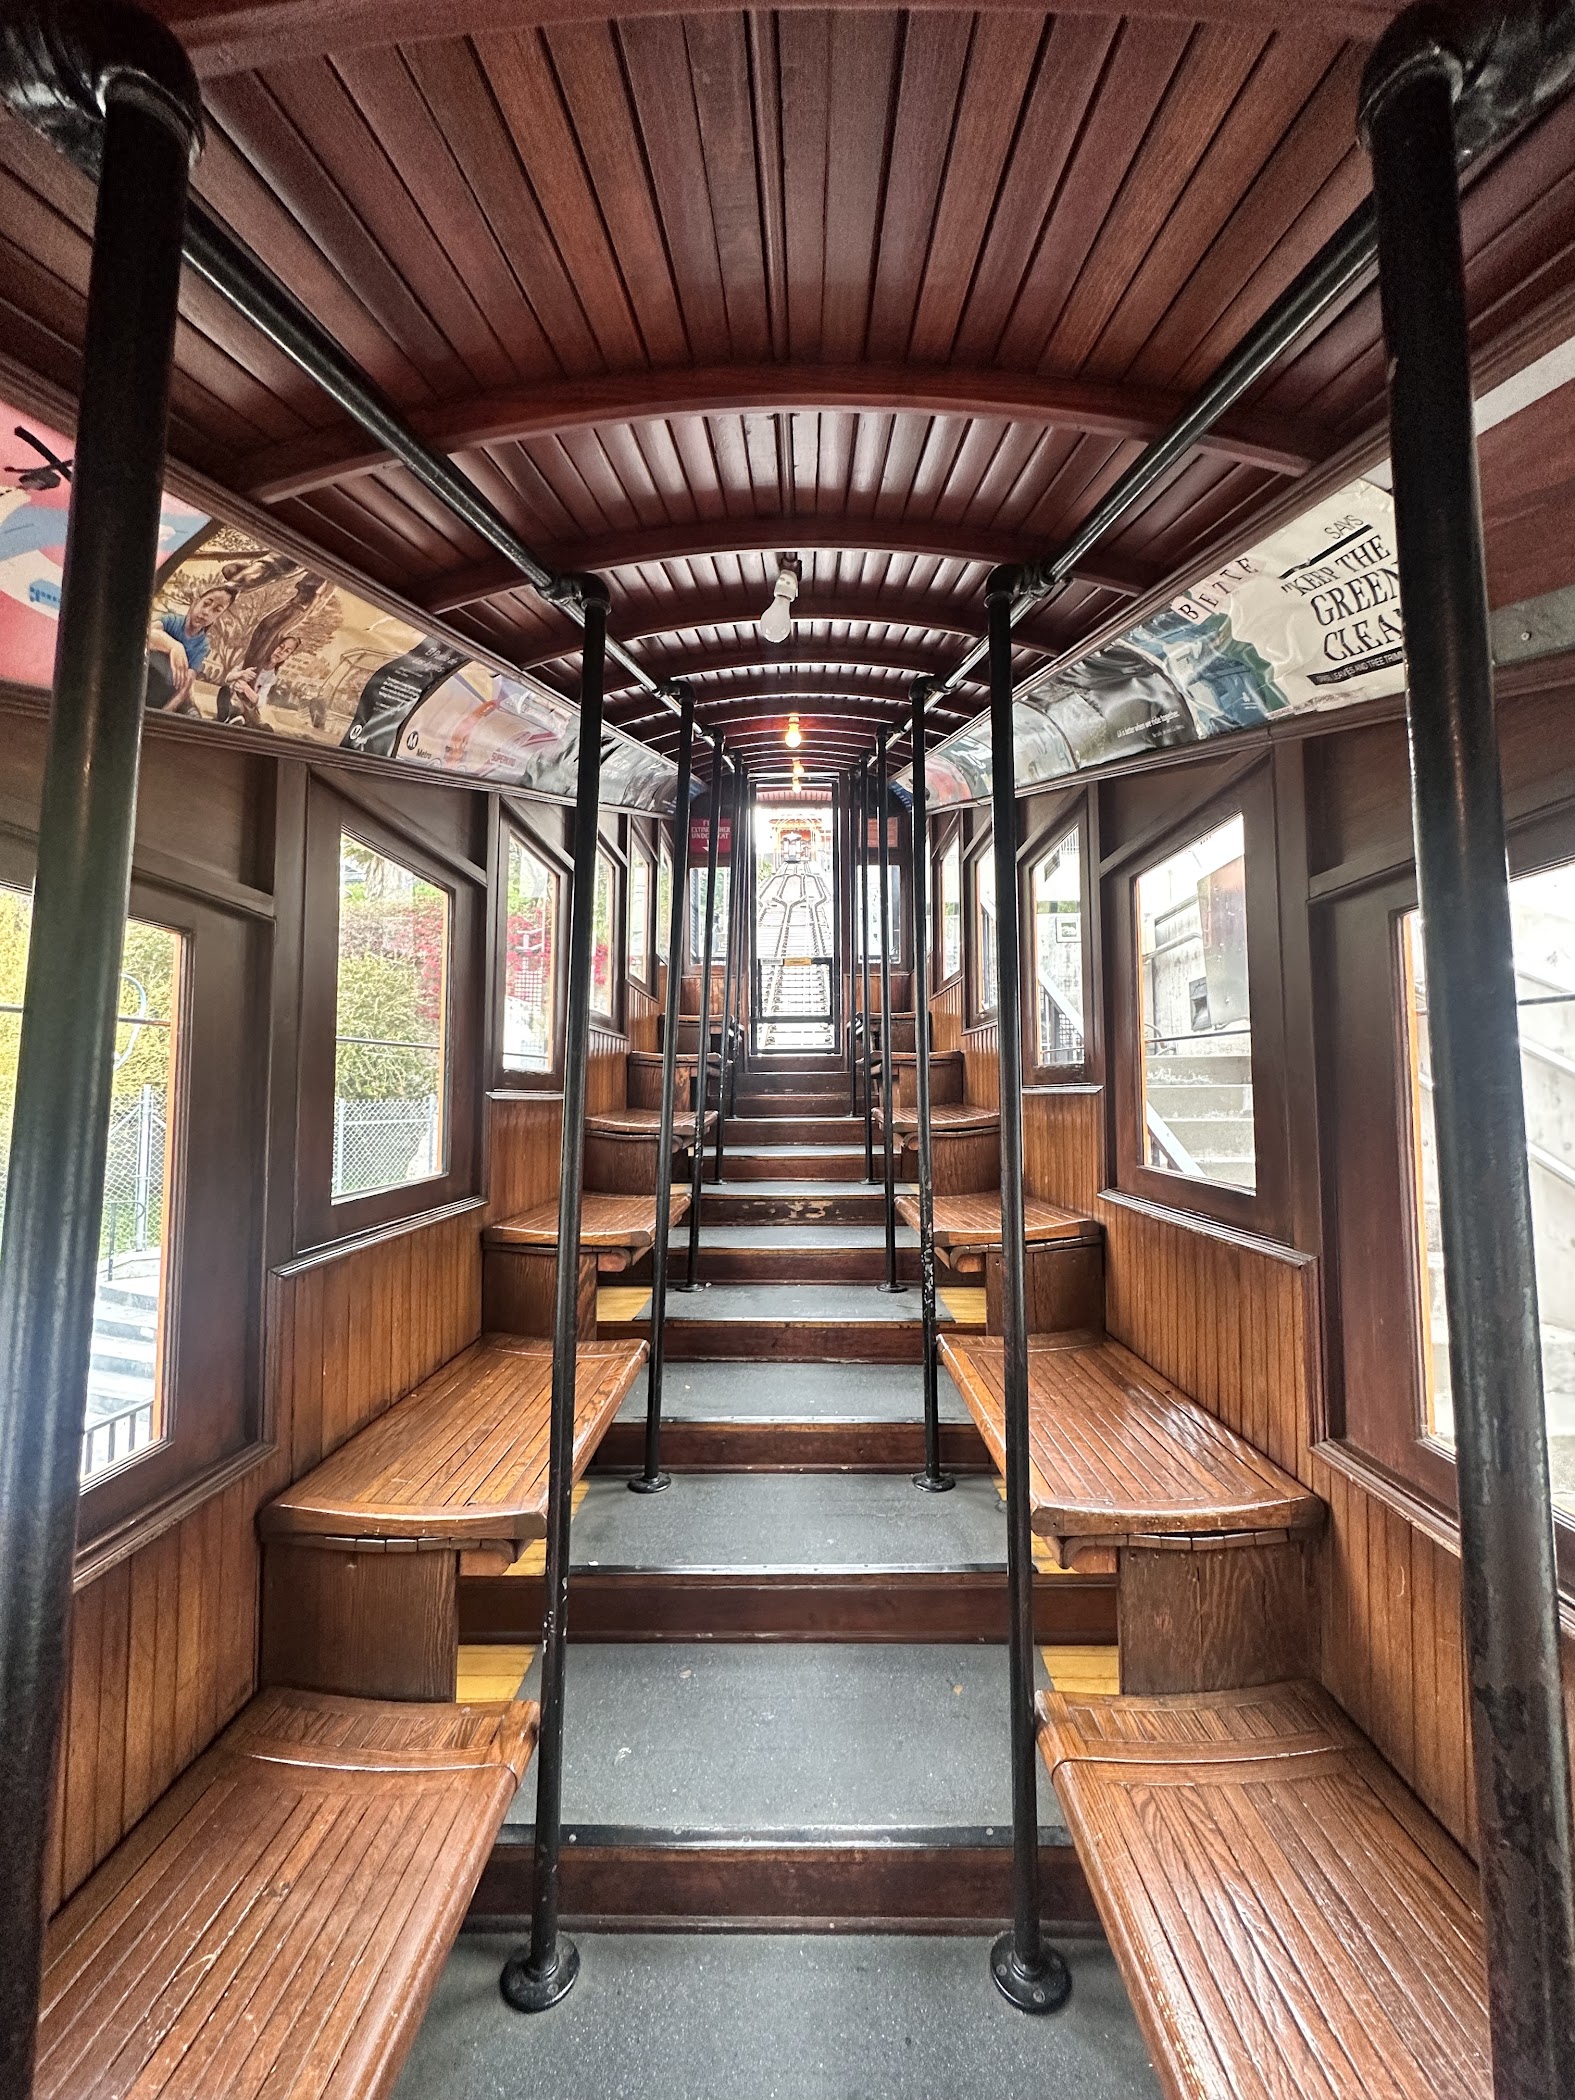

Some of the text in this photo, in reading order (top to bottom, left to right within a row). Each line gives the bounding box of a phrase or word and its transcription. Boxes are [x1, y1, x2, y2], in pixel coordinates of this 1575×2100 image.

[1324, 514, 1364, 540] SAYS
[1334, 534, 1391, 573] THE
[1178, 557, 1259, 620] BETTE
[1323, 608, 1402, 661] CLEA
[1367, 657, 1386, 669] TREE
[416, 748, 432, 759] Metro
